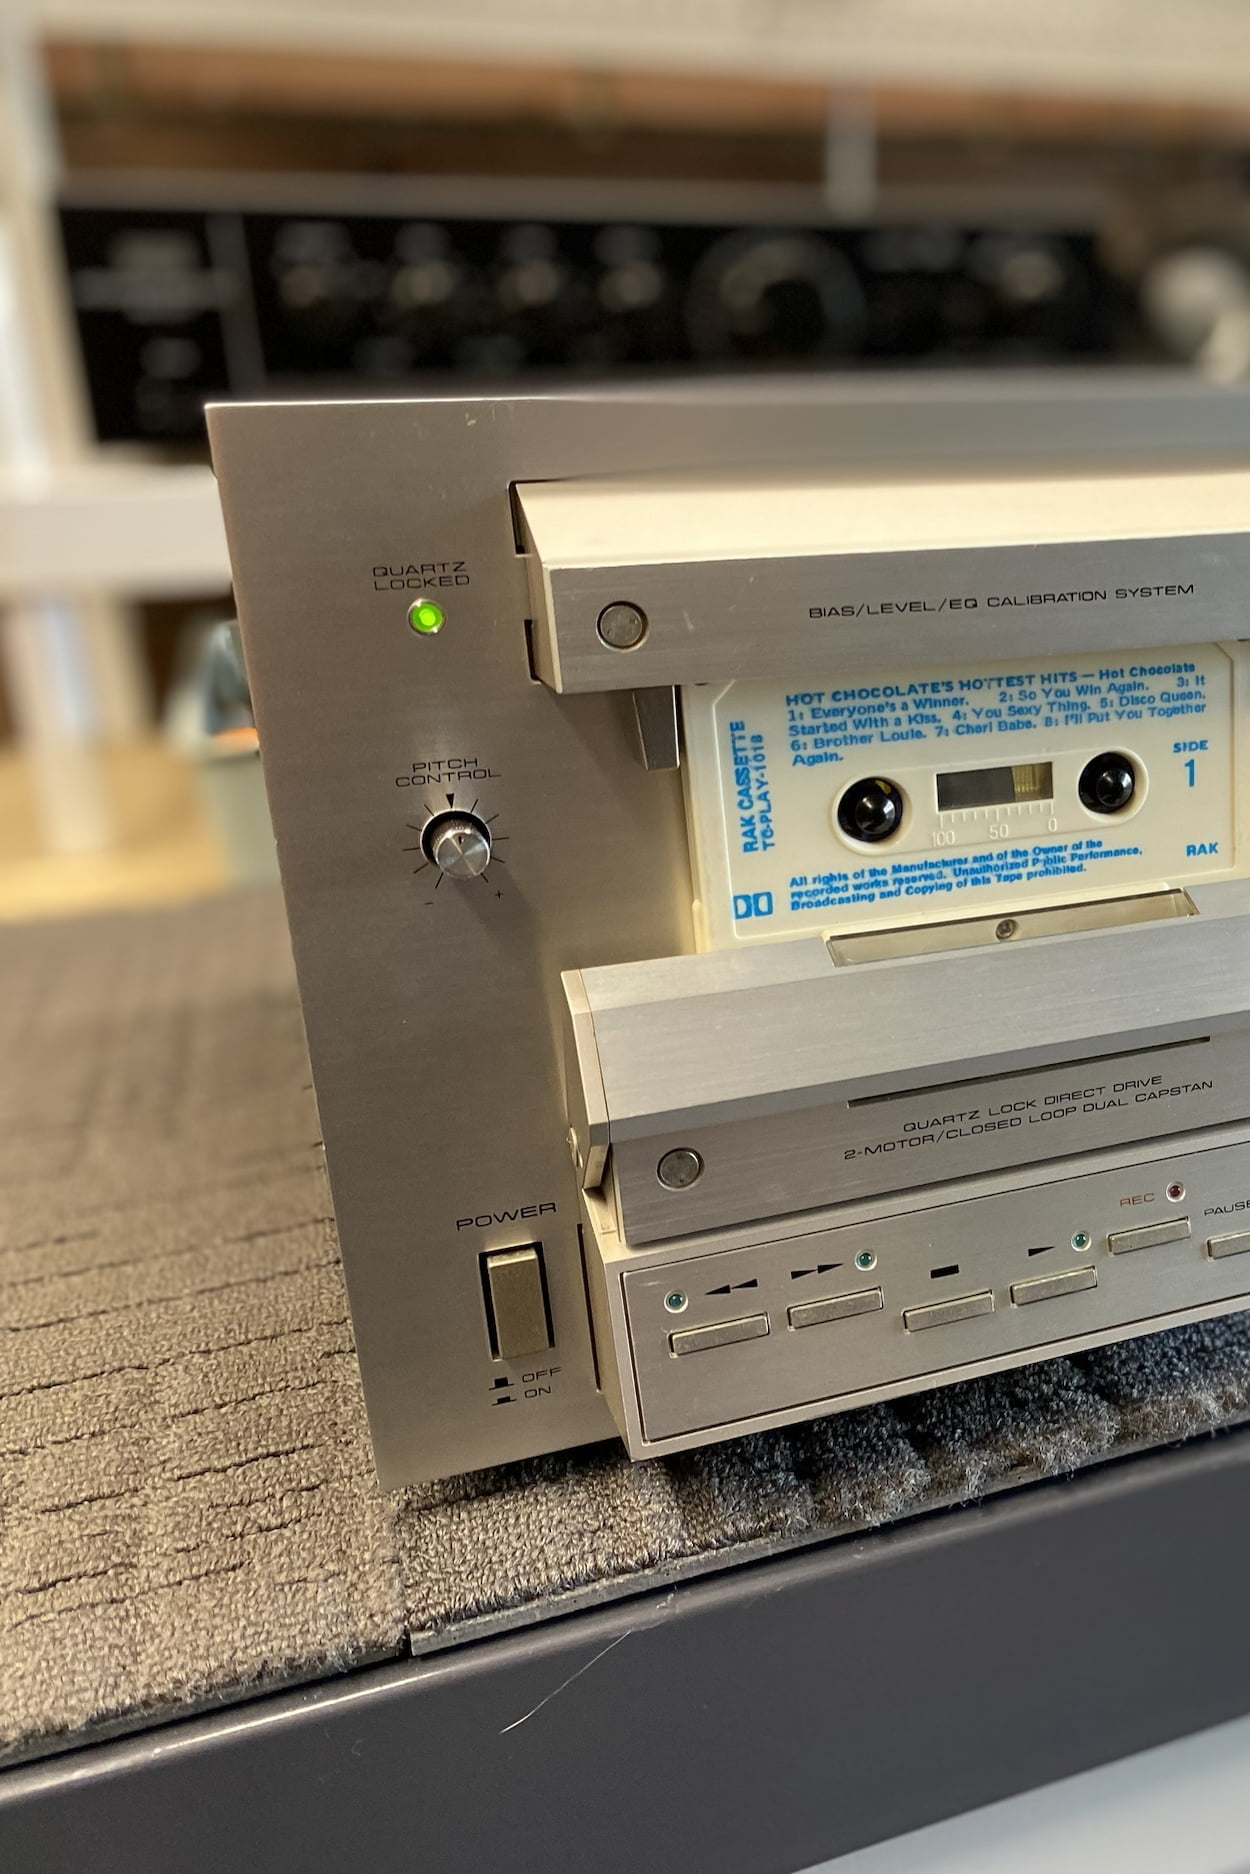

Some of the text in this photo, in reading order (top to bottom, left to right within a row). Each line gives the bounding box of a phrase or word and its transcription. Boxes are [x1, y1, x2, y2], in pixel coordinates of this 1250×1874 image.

[373, 561, 467, 577] QUARTZ
[374, 575, 470, 591] LOCKED
[809, 584, 1195, 619] BIAS/LEVEL/EQ CALIBRATION SYSTEM
[786, 692, 825, 707] HOT
[832, 680, 954, 703] CHOCOLATE'S
[958, 674, 1035, 692] HOTTEST
[1040, 671, 1078, 685] HITS
[1099, 666, 1124, 680] Hot
[1130, 662, 1195, 677] Chocolate
[788, 675, 1205, 722] 1: Everyone's a Winner. 2: So You Win Again. 3: It
[788, 689, 1206, 737] Started With a Kiss. 4: You Sexy Thing. 5: Disco Queen.
[790, 739, 808, 752] 6:
[814, 732, 874, 749] Brother
[880, 727, 927, 743] Louie.
[934, 725, 949, 738] 7:
[955, 722, 993, 736] Cheri
[998, 718, 1037, 732] Babe.
[1045, 716, 1059, 727] 8:
[1088, 710, 1110, 723] Put
[1115, 708, 1142, 720] You
[1149, 704, 1206, 719] Together
[792, 751, 844, 767] Again.
[1173, 740, 1208, 753] SIDE
[395, 768, 502, 787] CONTROL
[412, 757, 478, 773] PITCH
[1184, 759, 1195, 787] 1
[730, 720, 759, 853] RAK CASSETTE
[932, 818, 1058, 847] 100 50 0
[789, 839, 1103, 888] All rights of the Manufacturer and of the Owner of the
[1186, 842, 1218, 856] RAK
[790, 846, 1143, 900] recorded works reserved. Unauthorized Public Performance,
[790, 863, 1087, 912] Broadcasting and Copying of this Tape prohibited.
[903, 1075, 1163, 1133] QUARTZ LOCK DIRECT DRIVE
[844, 1080, 1213, 1160] 2-MOTOR/CLOSED LOOP DUAL CAPSTAN
[1120, 1192, 1155, 1207] REC
[456, 1202, 557, 1232] POWER
[522, 1366, 562, 1383] OFF
[524, 1386, 552, 1399] ON
